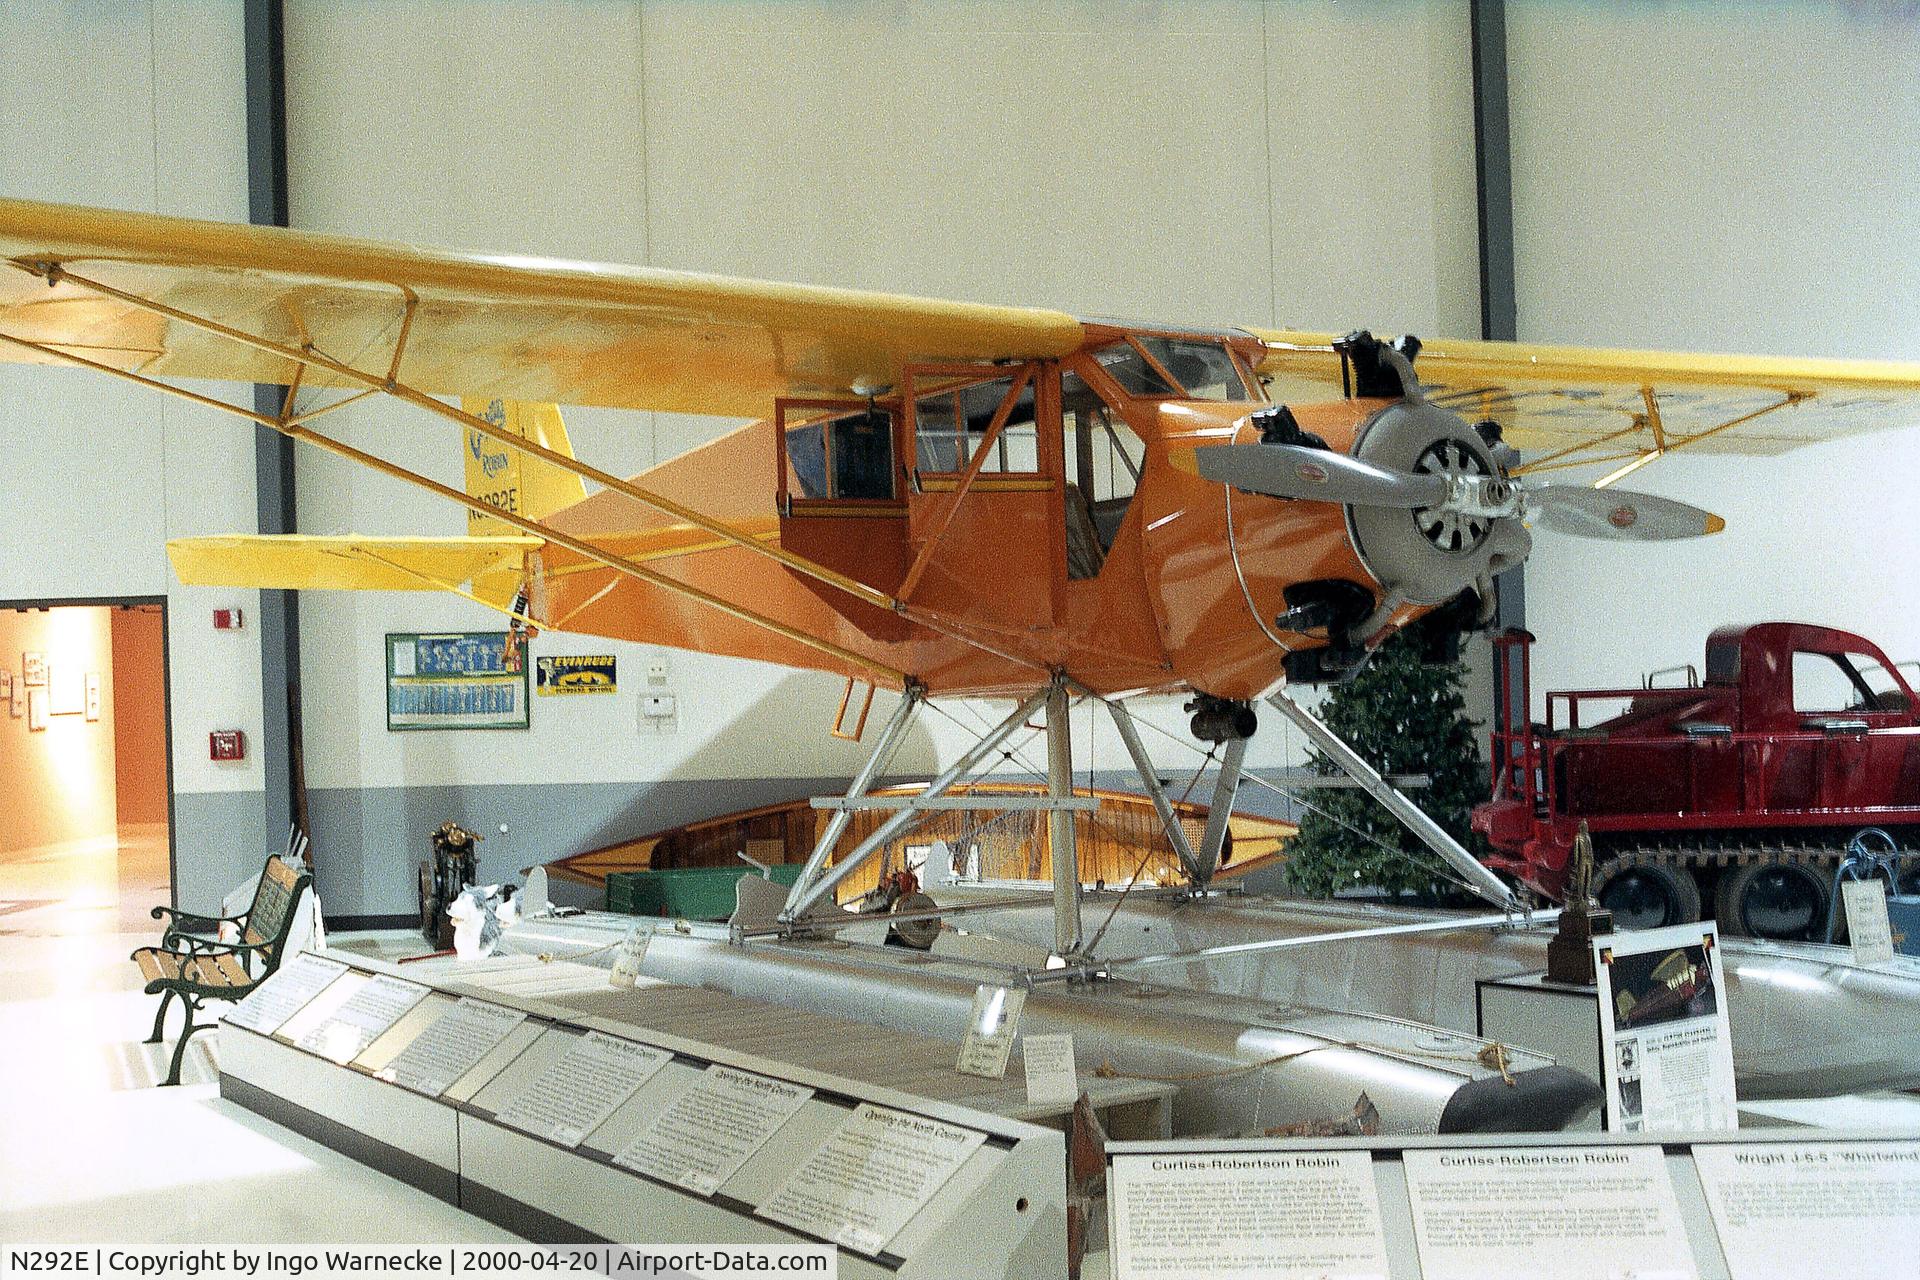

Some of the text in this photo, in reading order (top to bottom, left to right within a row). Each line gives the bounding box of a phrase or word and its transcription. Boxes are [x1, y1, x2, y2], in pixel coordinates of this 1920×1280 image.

[555, 656, 616, 667] EVINRUDE
[1295, 1157, 1340, 1169] Robin
[1584, 1152, 1630, 1164] Robin
[1734, 1153, 1786, 1167] Wright
